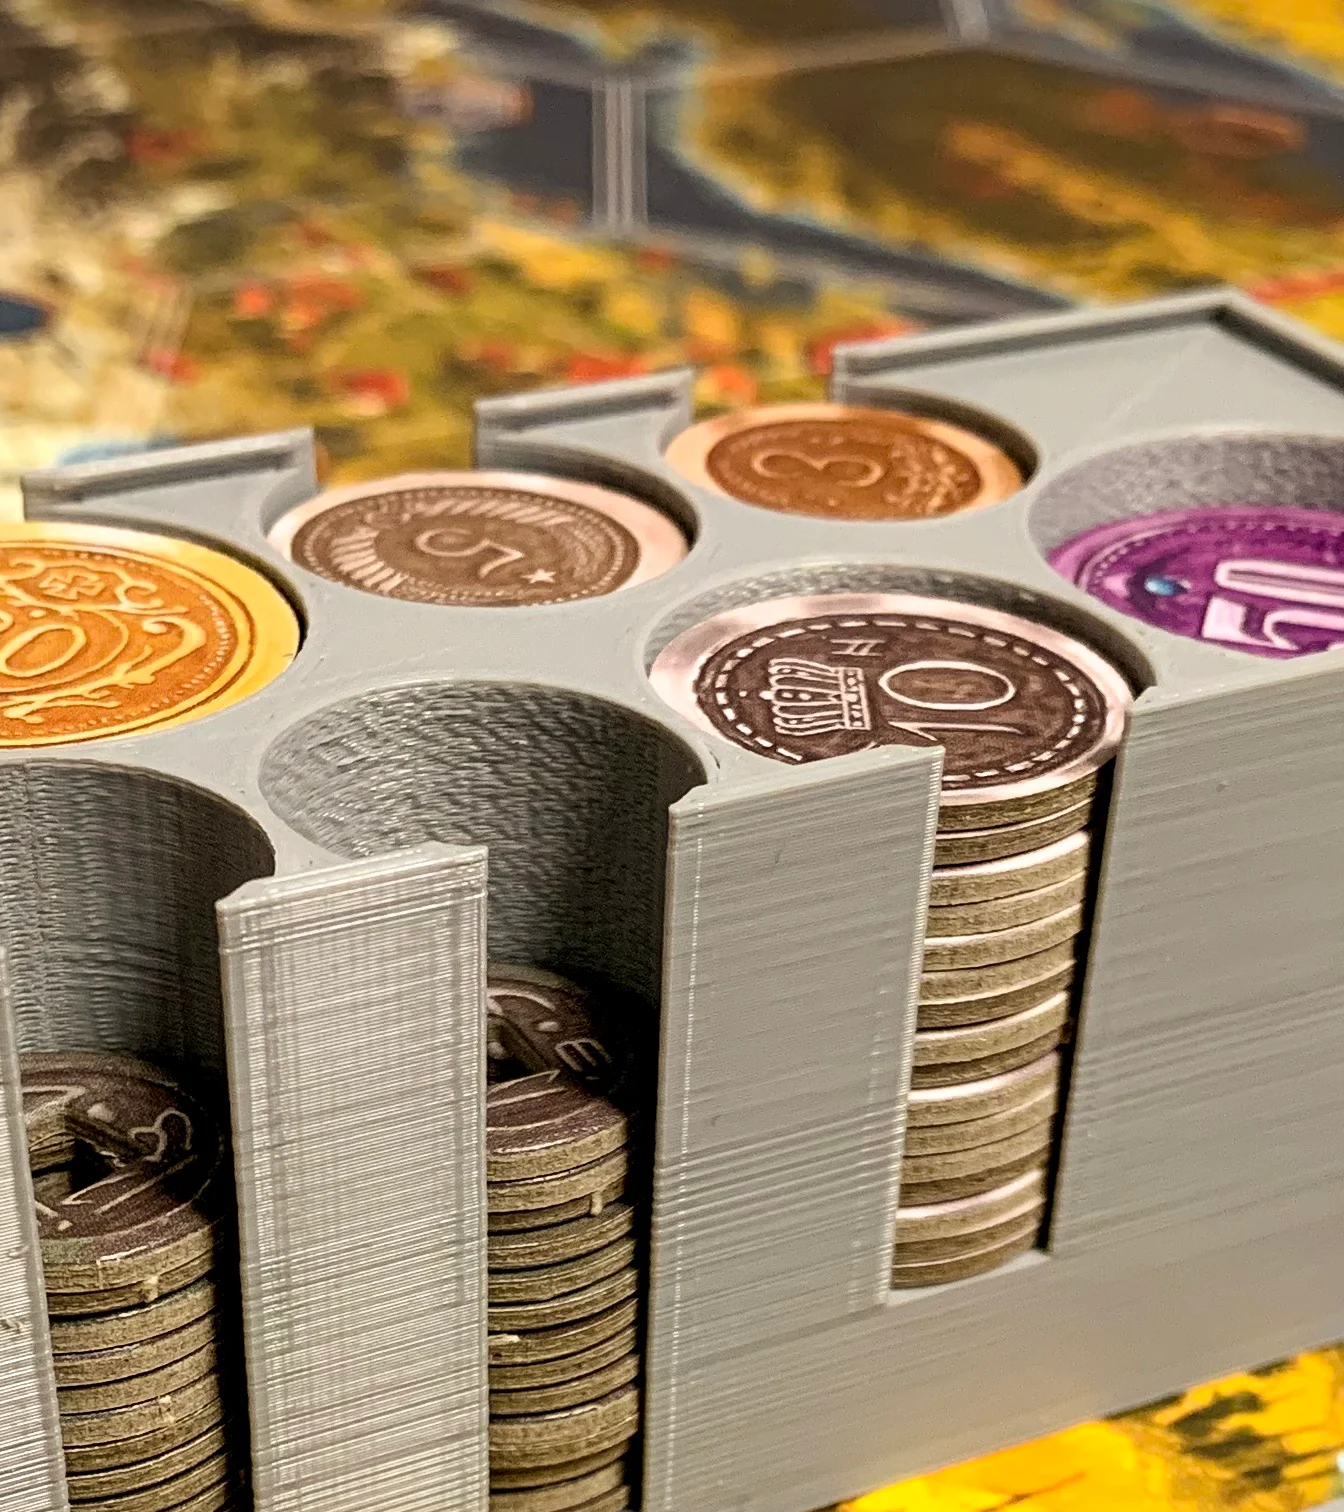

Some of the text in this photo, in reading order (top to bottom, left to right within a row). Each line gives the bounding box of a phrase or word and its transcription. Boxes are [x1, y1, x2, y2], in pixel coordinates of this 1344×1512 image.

[751, 449, 884, 487] 3
[414, 527, 525, 579] 5
[877, 659, 1028, 742] 10
